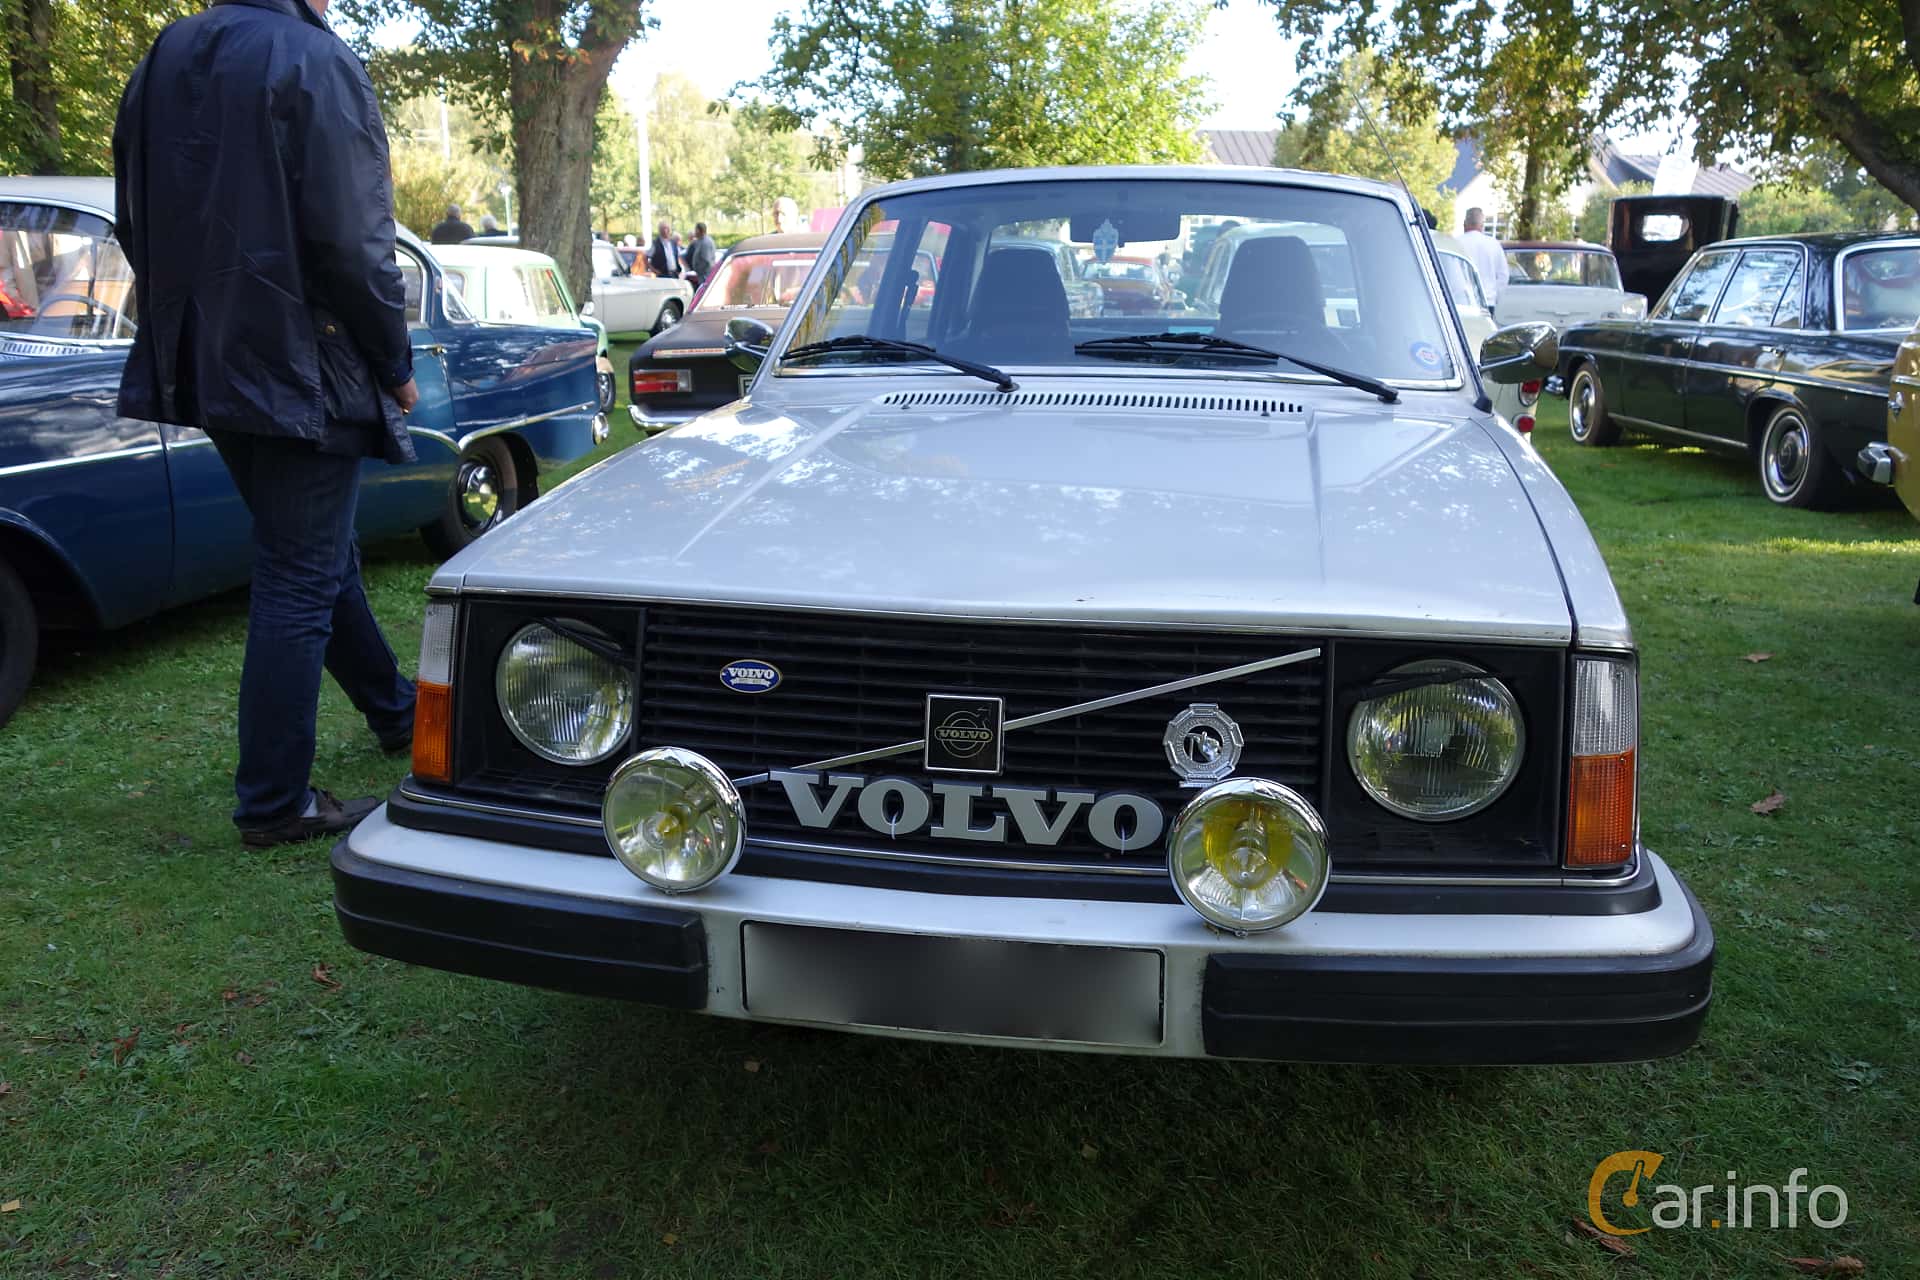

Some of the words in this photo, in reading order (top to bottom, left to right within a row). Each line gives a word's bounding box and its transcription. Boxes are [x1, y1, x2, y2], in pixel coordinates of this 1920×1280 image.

[728, 667, 775, 679] VOLVO
[939, 729, 990, 740] VOLVO
[770, 770, 1164, 851] VOLVO
